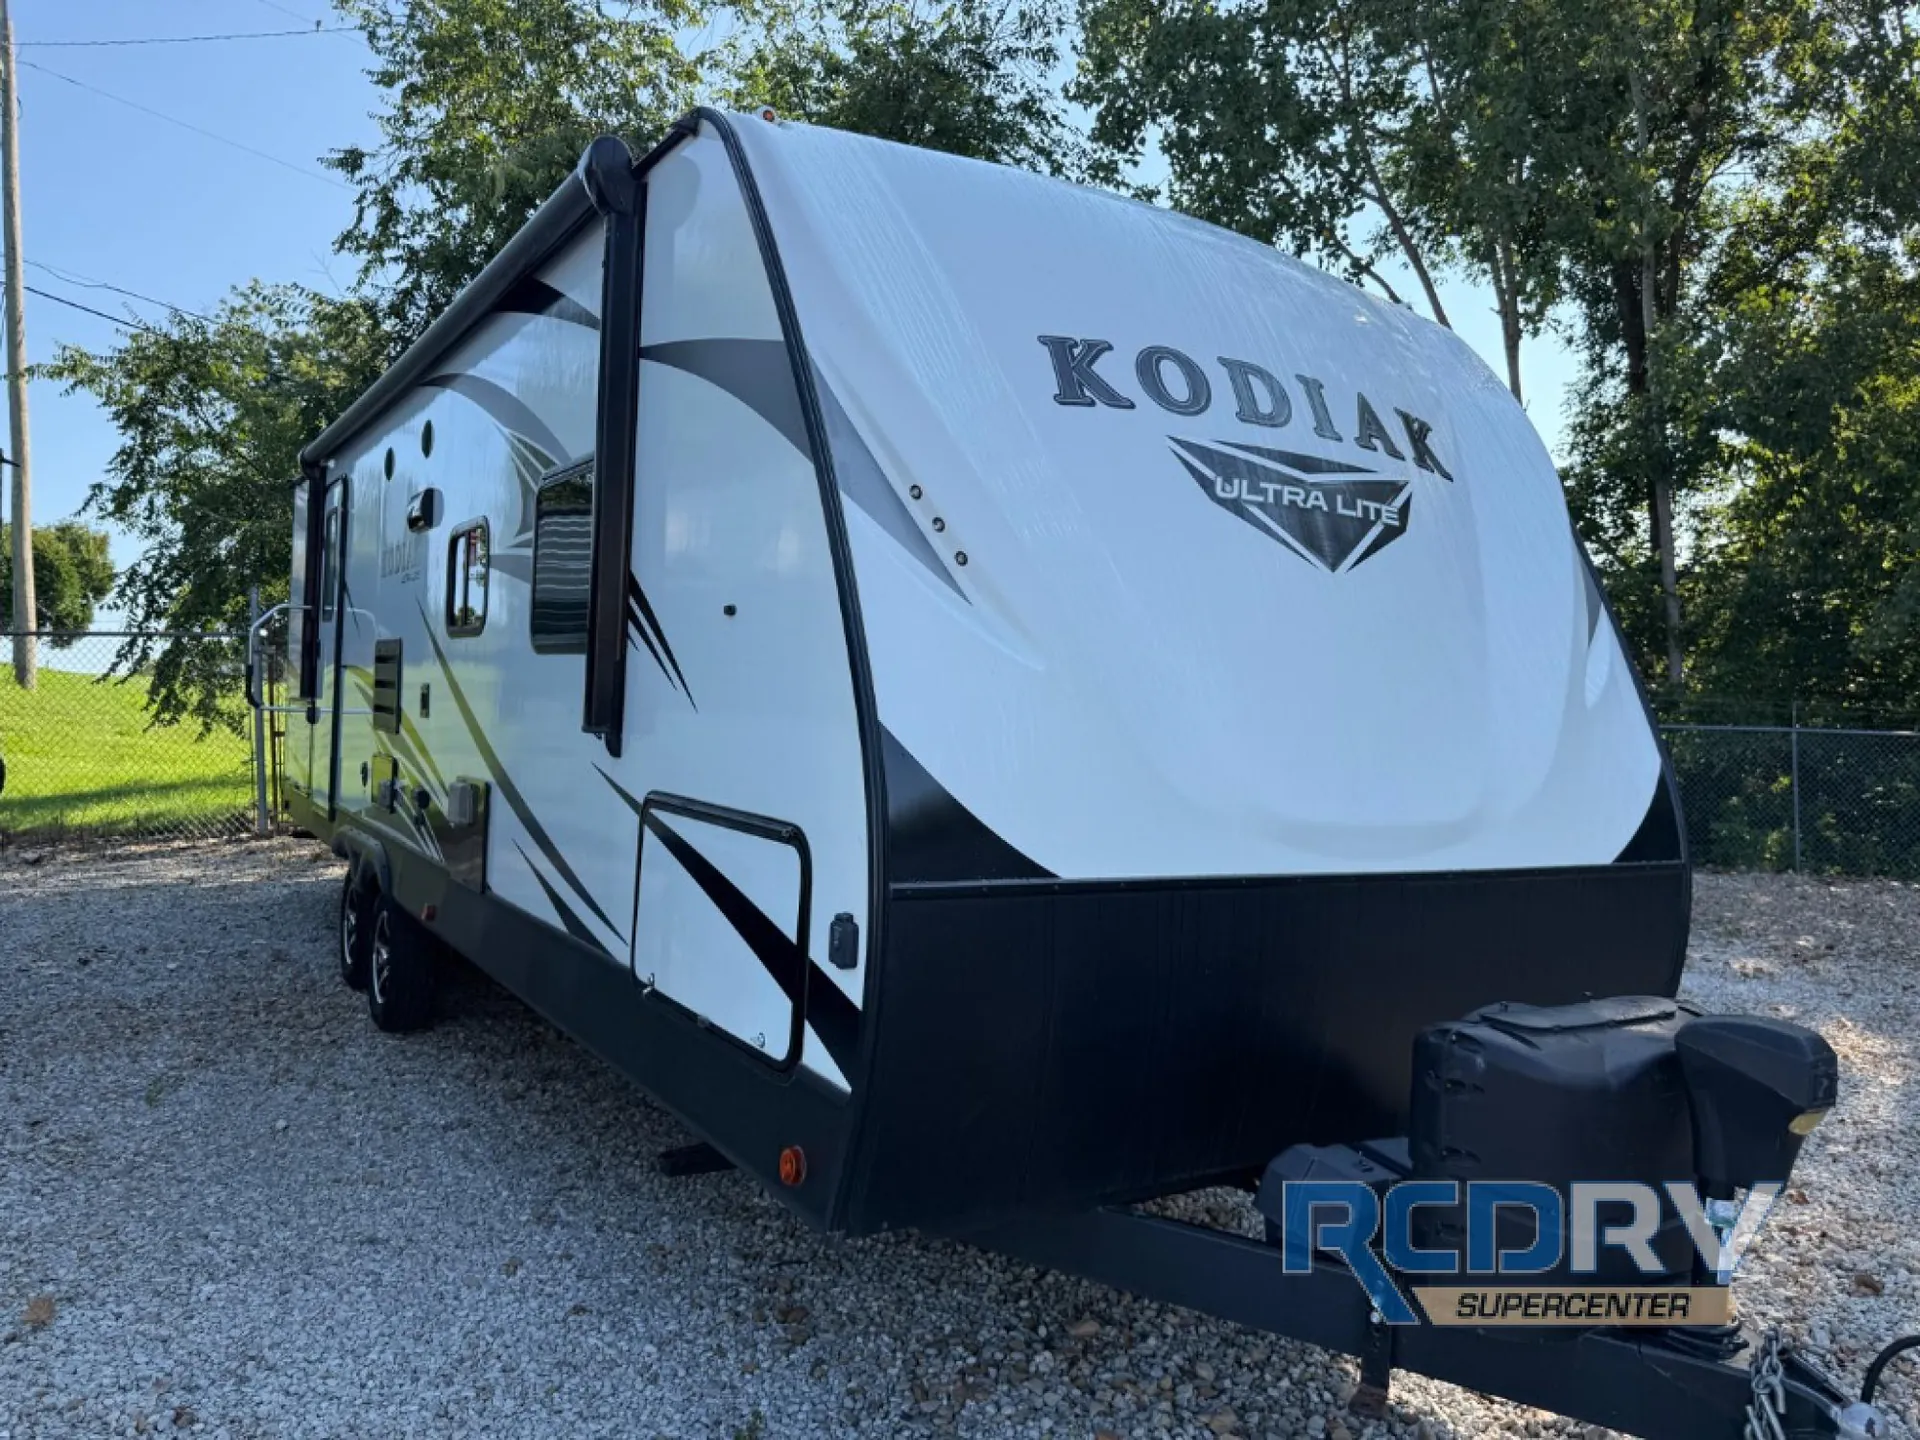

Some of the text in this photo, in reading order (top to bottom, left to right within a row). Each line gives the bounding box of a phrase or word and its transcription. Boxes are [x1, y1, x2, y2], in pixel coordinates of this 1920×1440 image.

[1037, 335, 1454, 482] KODIAK
[1213, 475, 1401, 526] ULTRA LITE
